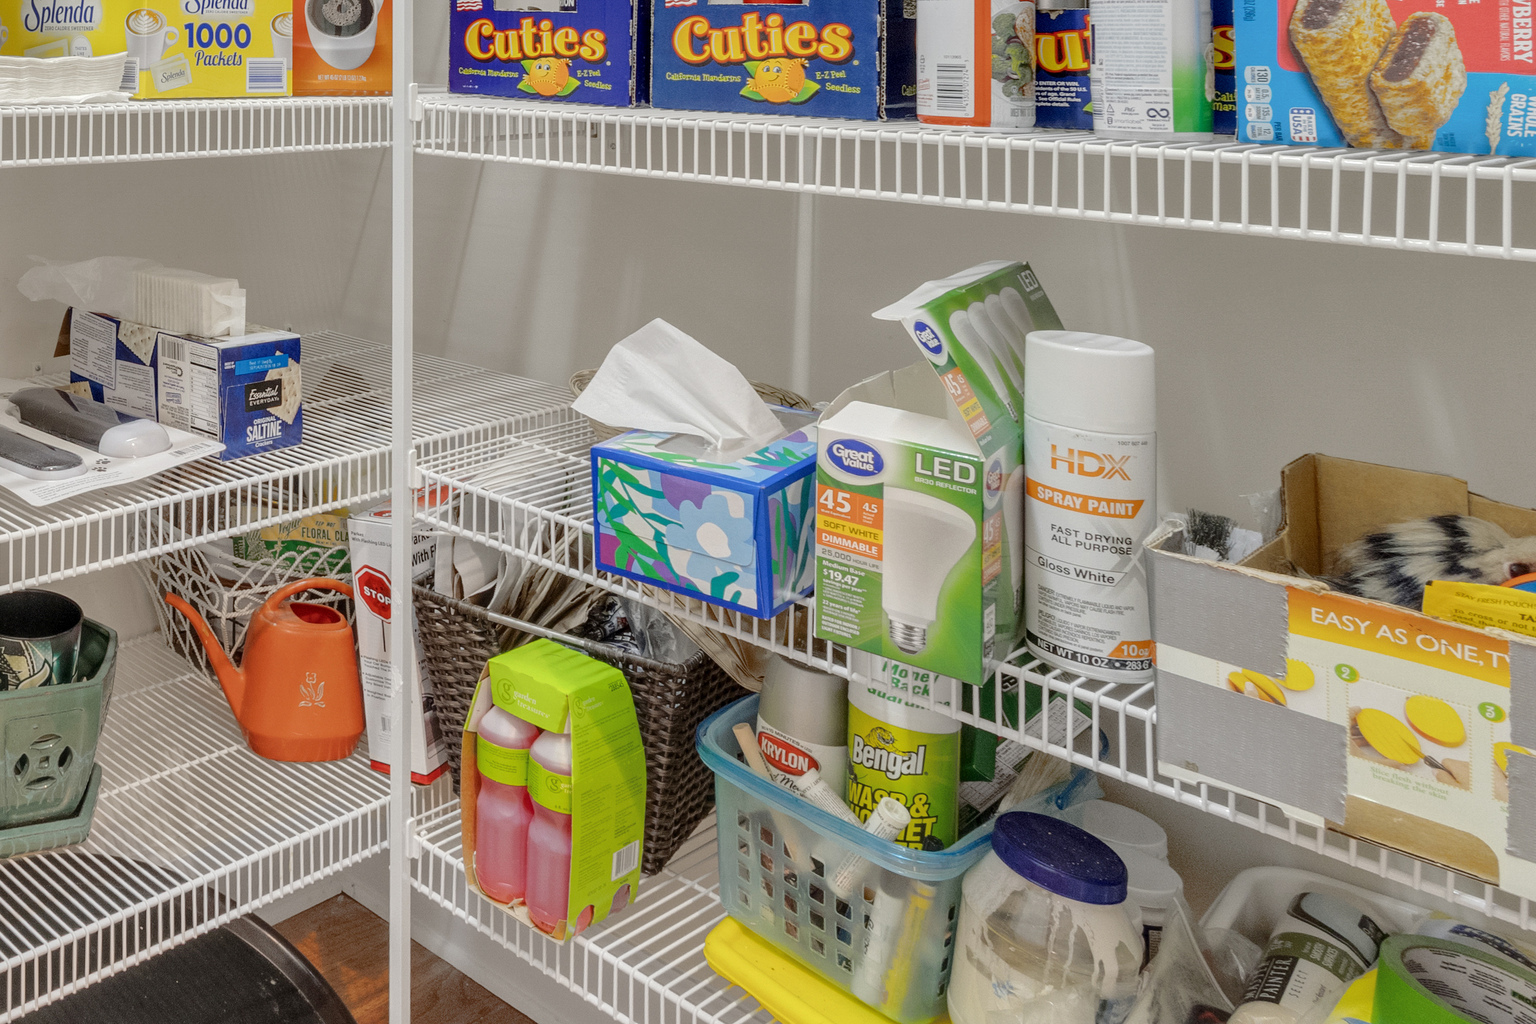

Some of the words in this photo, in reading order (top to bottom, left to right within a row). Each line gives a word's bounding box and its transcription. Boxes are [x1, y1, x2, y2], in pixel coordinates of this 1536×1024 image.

[184, 22, 252, 49] 1000
[464, 16, 607, 61] Cuties
[671, 11, 854, 64] Cuties
[194, 50, 243, 67] Packets
[584, 80, 612, 90] Seedless
[665, 72, 701, 82] California
[702, 73, 741, 82] Mandarins
[831, 70, 847, 79] Peel
[1257, 68, 1269, 83] 130
[825, 82, 861, 94] Seedless
[1291, 115, 1303, 135] USA
[1507, 93, 1527, 137] GRAINS
[1016, 269, 1040, 293] LED
[248, 385, 279, 401] Essential
[944, 374, 962, 397] 45
[249, 397, 278, 407] EVERYDAY
[246, 420, 282, 442] SALTINE
[832, 443, 875, 465] Great
[841, 455, 875, 472] Value
[1050, 444, 1132, 481] HDX
[914, 452, 977, 485] LED
[914, 476, 935, 486] BR30
[935, 481, 977, 495] REFLECTOR
[819, 488, 852, 513] 45
[862, 501, 878, 514] 4.5
[1037, 486, 1083, 509] SPRAY
[1088, 499, 1135, 516] PAINT
[301, 526, 331, 541] FLORAL
[823, 519, 847, 532] SOFT
[848, 525, 879, 541] WHITE
[1050, 523, 1080, 538] FAST
[1084, 532, 1133, 546] DRYING
[821, 532, 878, 555] DIMMABLE
[1050, 534, 1072, 547] ALL
[1075, 539, 1133, 555] PURPOSE
[821, 548, 852, 562] 25,000
[822, 559, 849, 572] Medium
[849, 567, 866, 577] Base
[822, 568, 859, 587] $19.47
[1037, 556, 1071, 576] Gloss
[1073, 567, 1115, 584] White
[364, 585, 391, 606] STOP
[1476, 597, 1502, 605] FRESH
[1311, 607, 1371, 635] EASY
[1376, 624, 1408, 645] AS
[1415, 633, 1484, 666] ONE,
[1037, 639, 1054, 653] NET
[1056, 645, 1074, 659] WT
[1076, 649, 1090, 664] 10
[1091, 654, 1109, 668] OZ
[1126, 660, 1142, 671] 283
[1121, 644, 1138, 657] 10
[513, 690, 537, 706] garden
[517, 699, 549, 719] treasures
[761, 736, 809, 773] KRYLON
[852, 733, 927, 781] Bengal
[1369, 765, 1390, 778] Slice
[1391, 772, 1413, 785] flesh
[1415, 780, 1449, 796] without
[1372, 772, 1409, 790] breaking
[910, 792, 931, 818] &
[1262, 957, 1293, 999] PAINTER
[1290, 969, 1309, 998] SELECT
